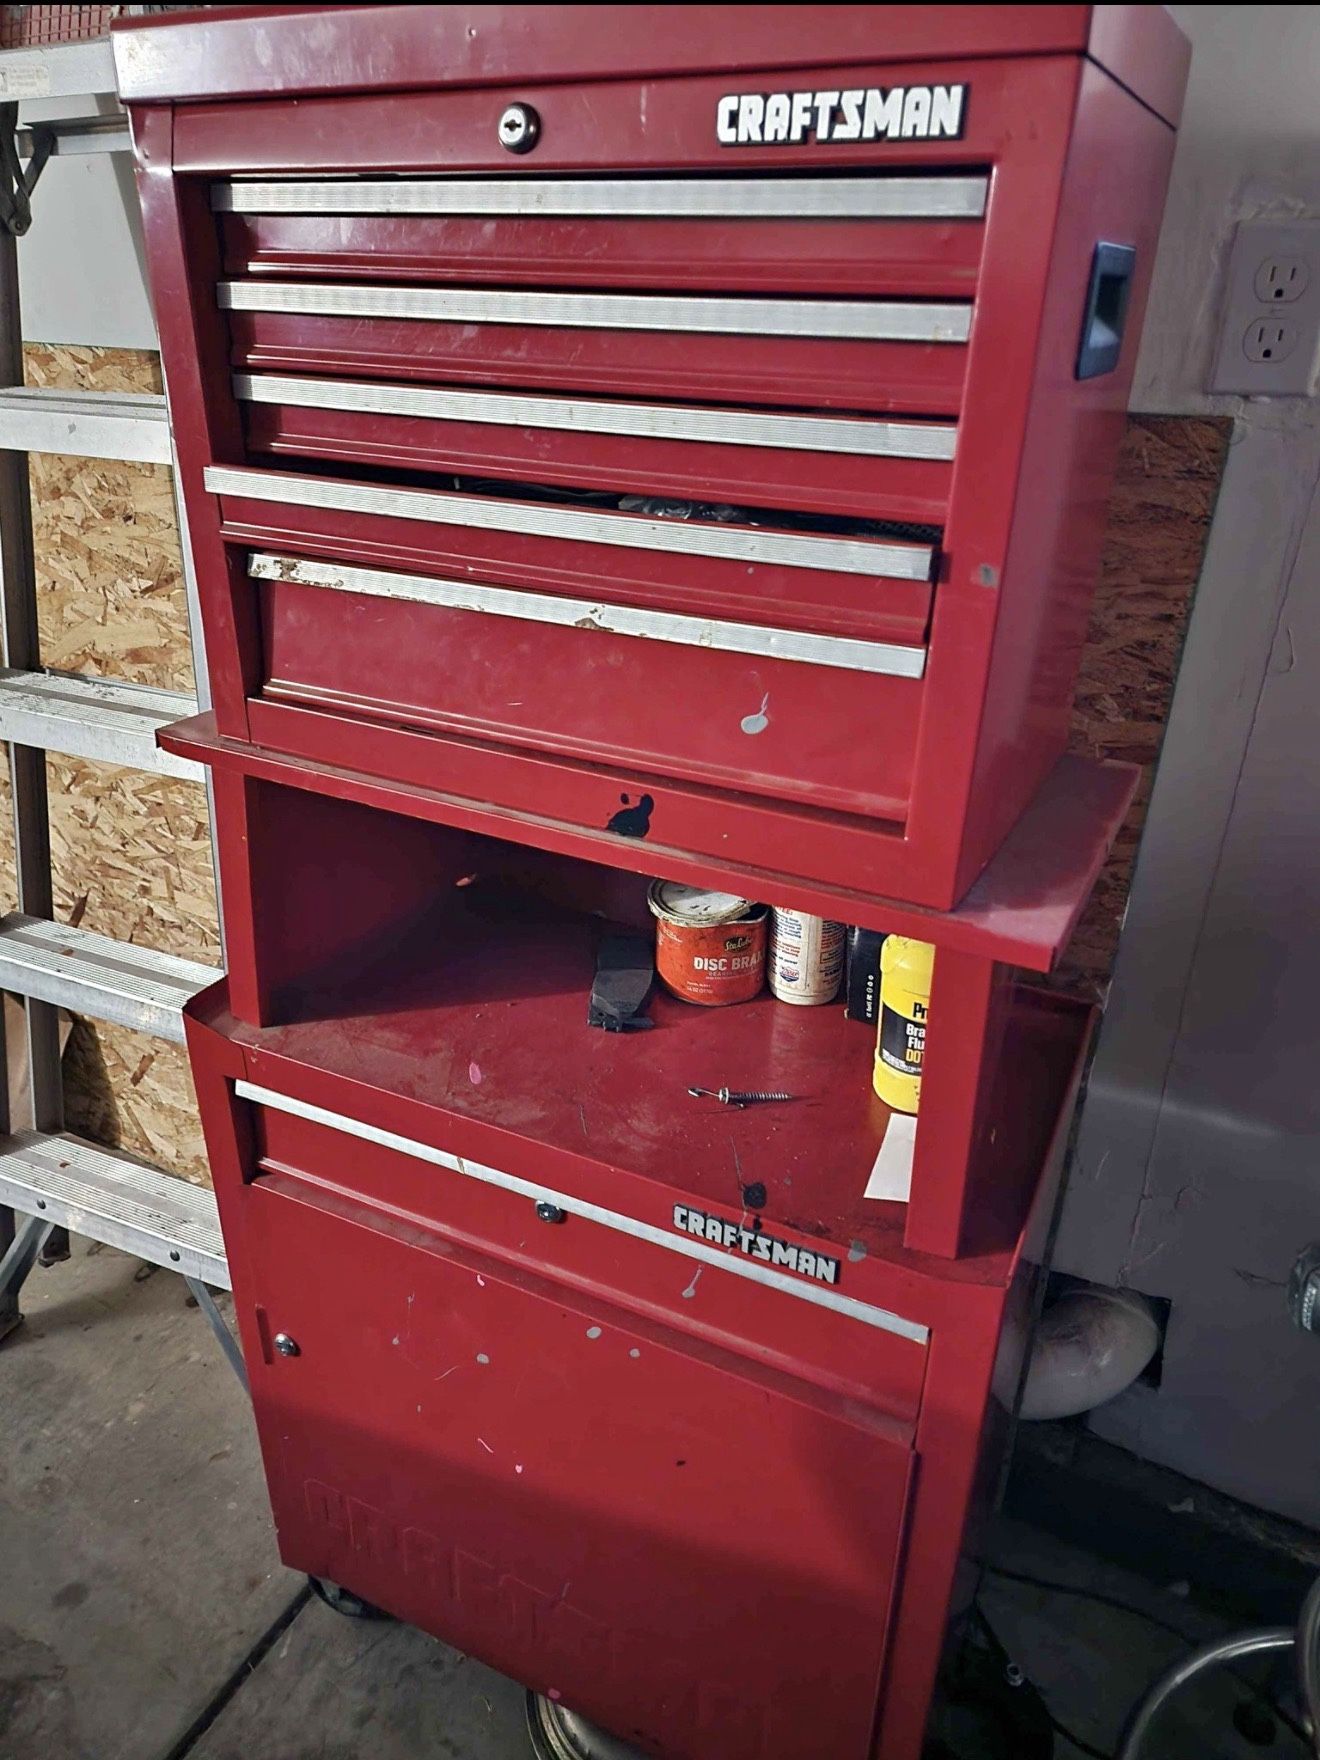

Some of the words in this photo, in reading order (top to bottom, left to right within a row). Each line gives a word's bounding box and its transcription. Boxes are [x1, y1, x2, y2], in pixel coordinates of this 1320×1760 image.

[717, 84, 964, 144] CRAFTSMAN
[693, 956, 728, 971] DISC
[673, 1205, 837, 1285] CRAFTSMAN
